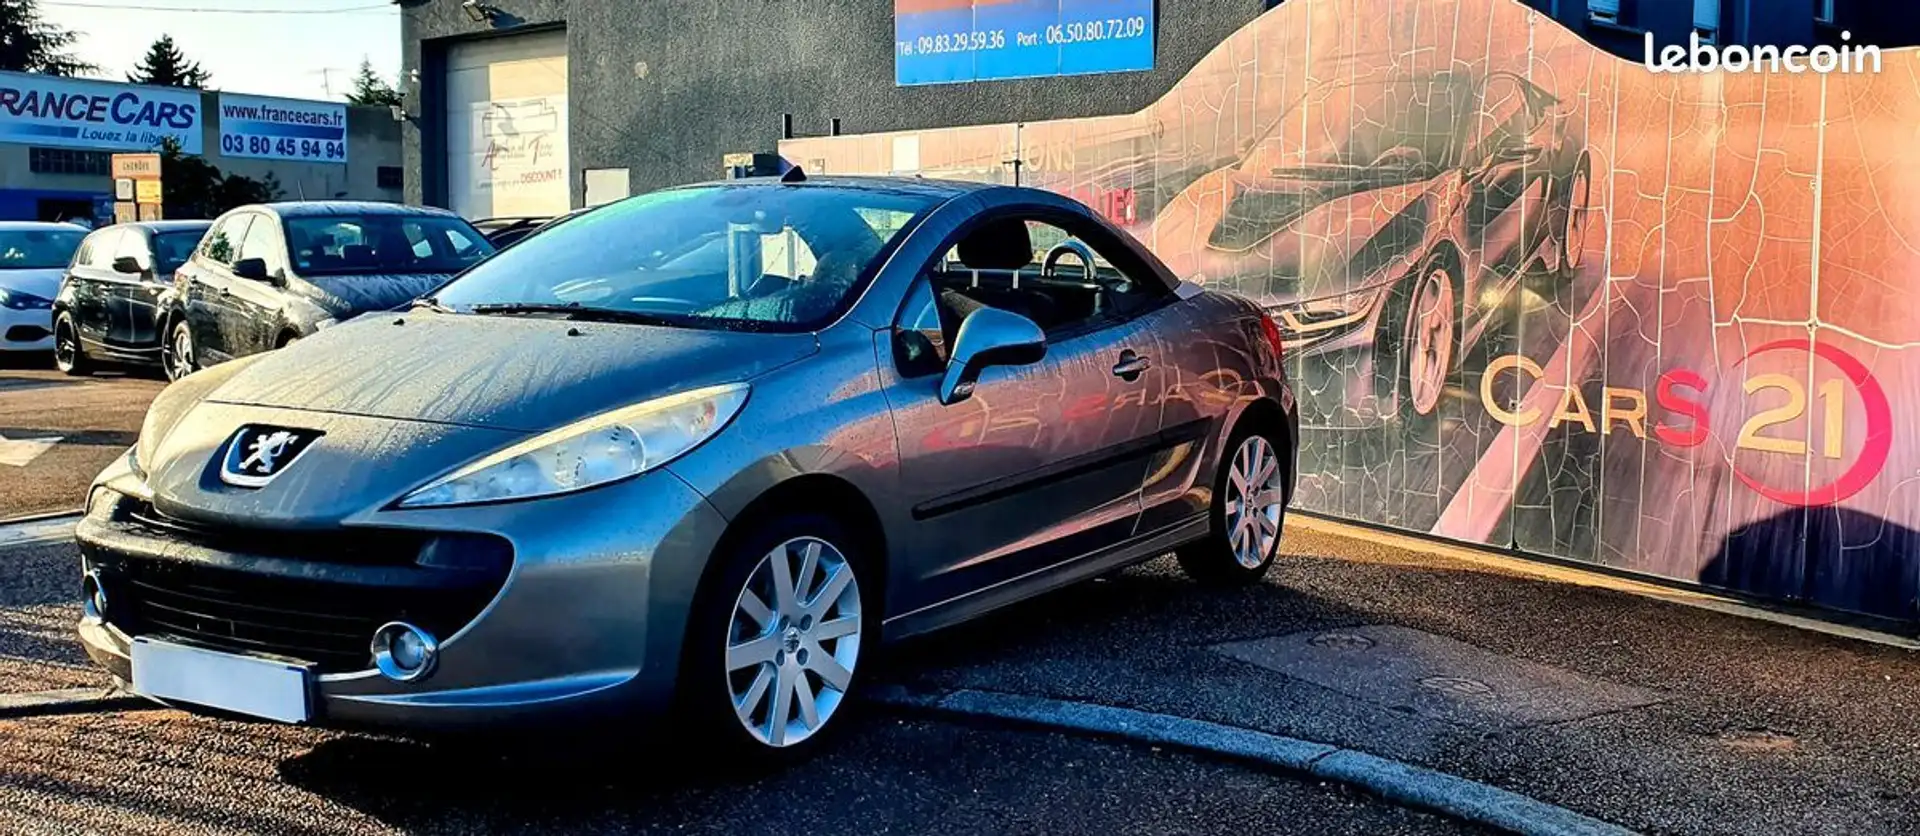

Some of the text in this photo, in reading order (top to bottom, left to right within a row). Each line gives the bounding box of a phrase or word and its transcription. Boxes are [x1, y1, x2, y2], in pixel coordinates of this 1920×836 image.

[918, 30, 1005, 54] 09.83.29.59.36
[1046, 17, 1144, 44] 06.50.80.72.09
[223, 104, 343, 126] www.francecars.fr
[81, 128, 121, 140] Louez
[126, 131, 137, 143] la
[223, 134, 345, 159] 03 80 45 94 94
[1480, 355, 1844, 459] CARS 21
